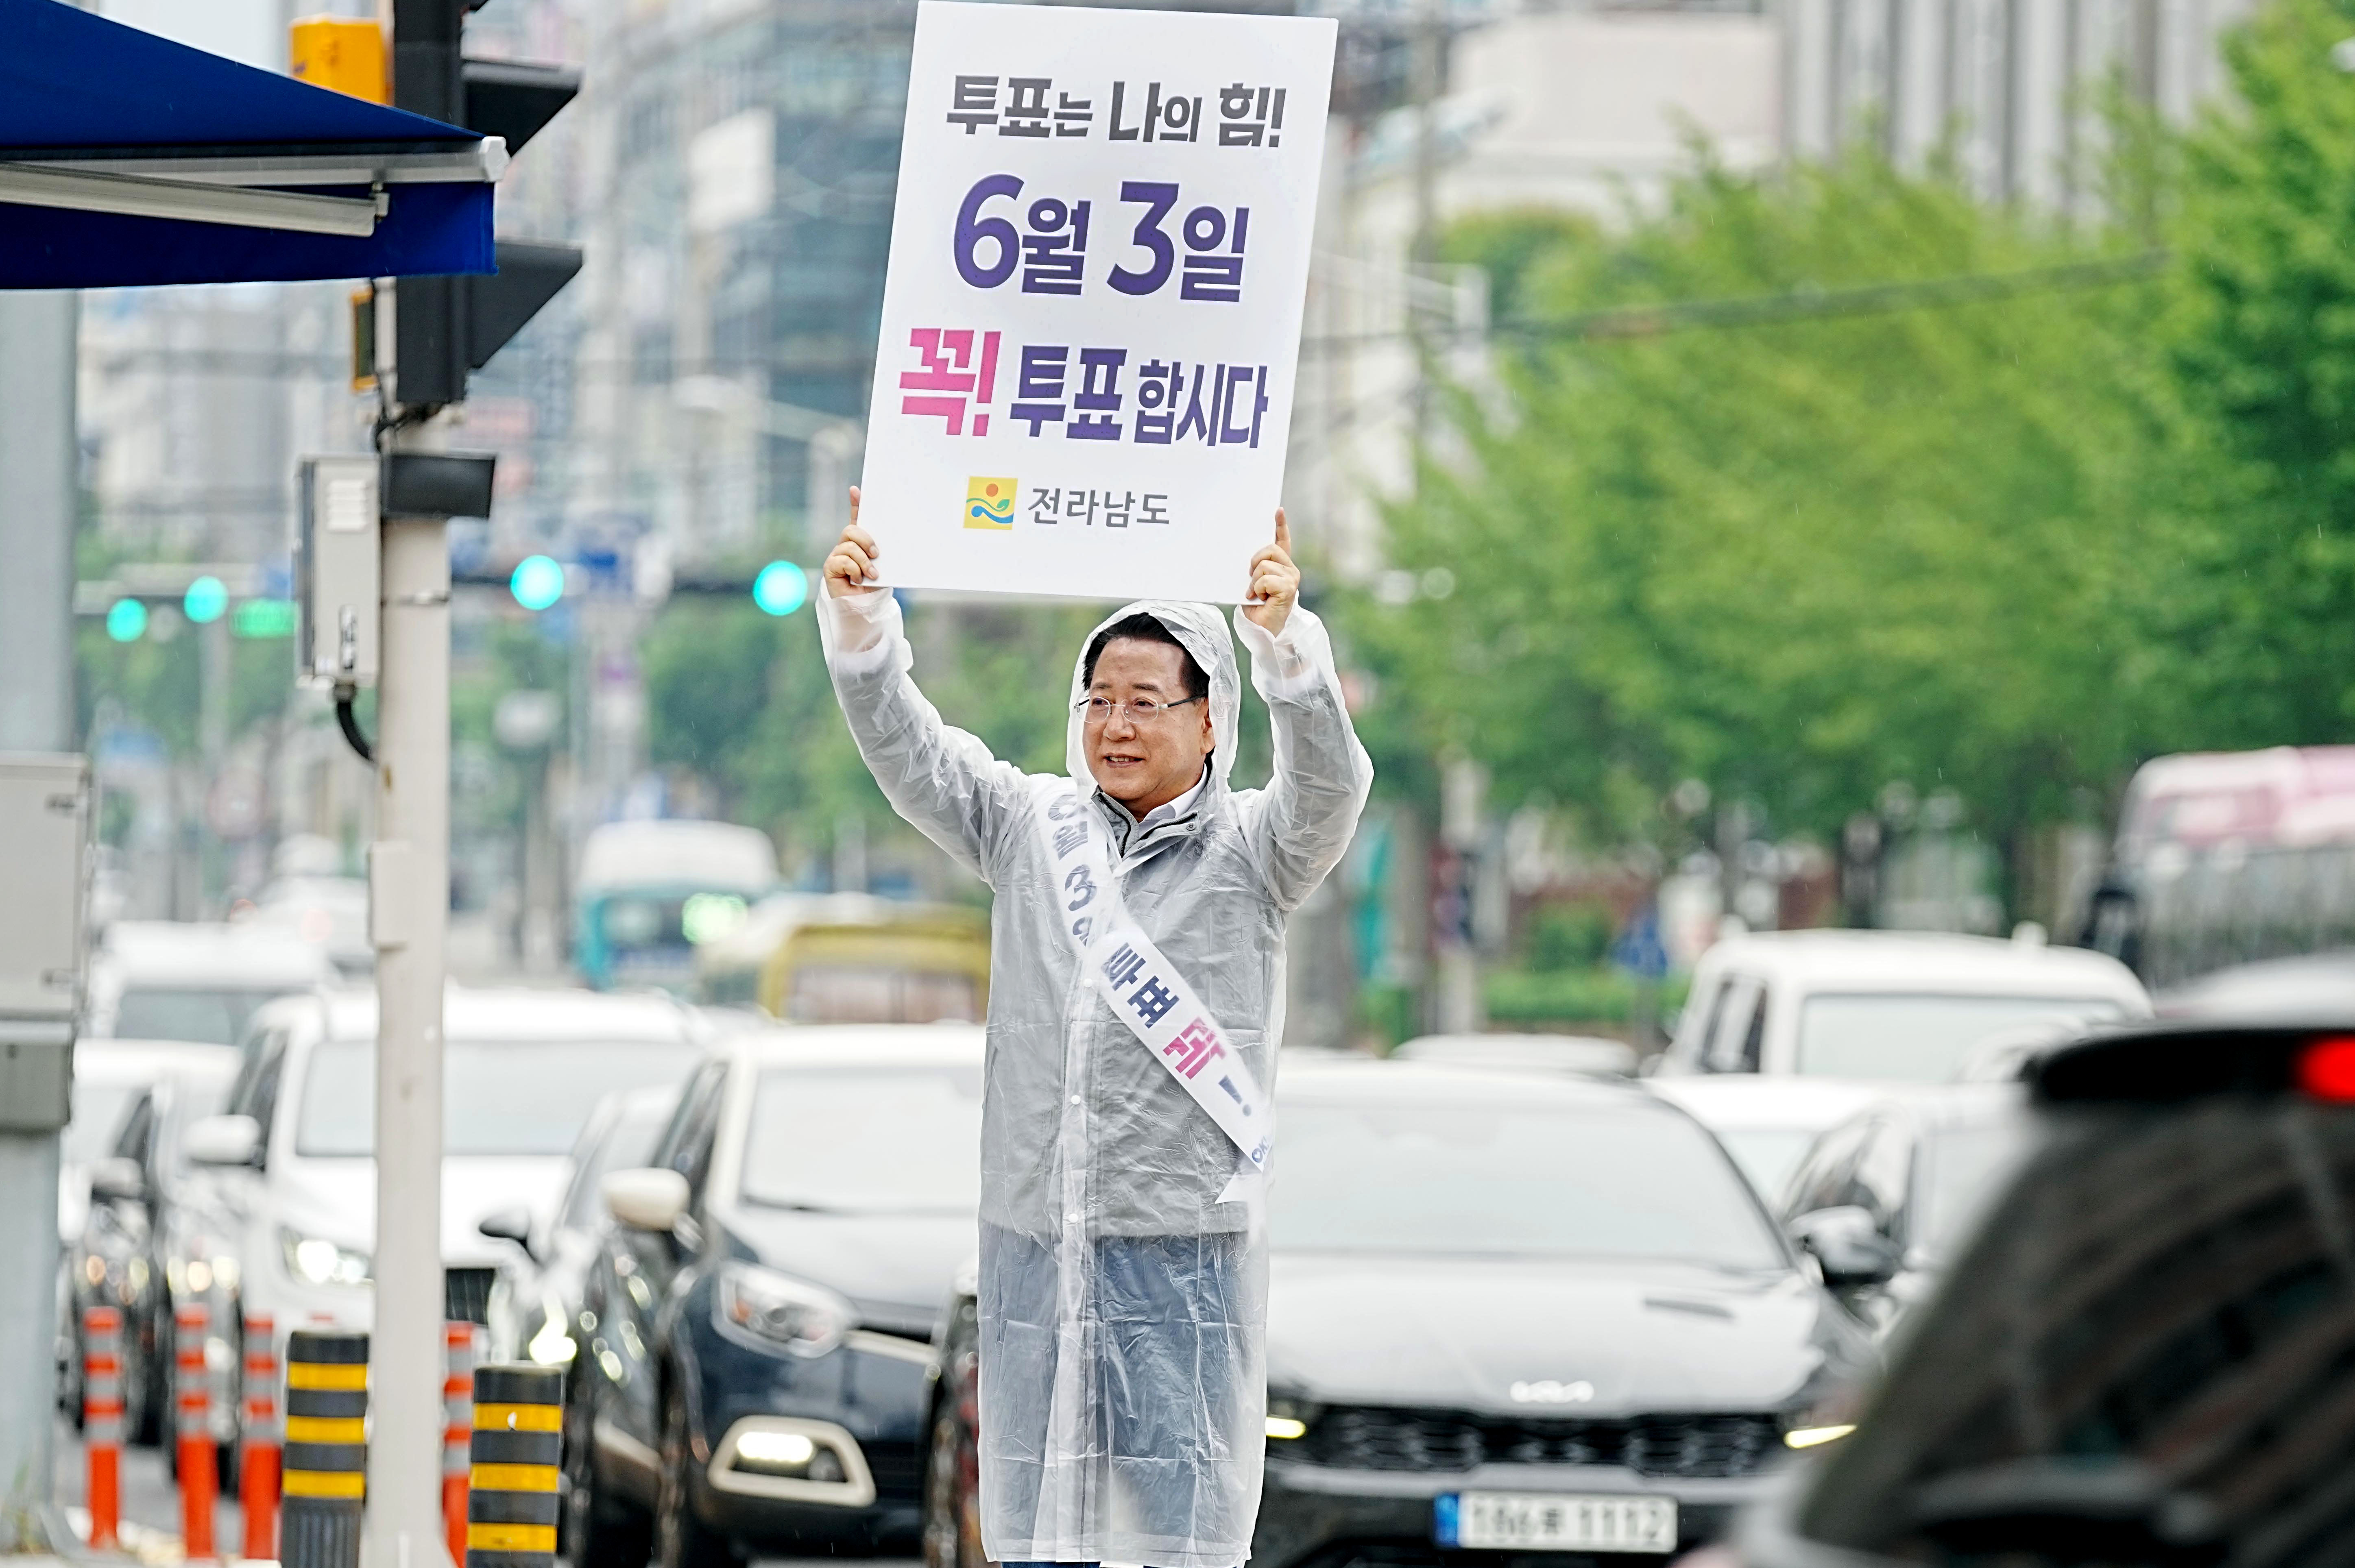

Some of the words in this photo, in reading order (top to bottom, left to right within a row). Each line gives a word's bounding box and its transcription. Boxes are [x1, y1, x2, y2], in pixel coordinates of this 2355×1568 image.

[946, 75, 1094, 138] 투표는
[1108, 81, 1203, 143] 나의
[1219, 82, 1287, 148] 힘!
[953, 173, 1092, 296] 6월
[1106, 180, 1250, 303] 3일
[898, 328, 1002, 437] 꼭!
[1028, 488, 1170, 528] 전라남도
[1101, 942, 1180, 1029] 투표
